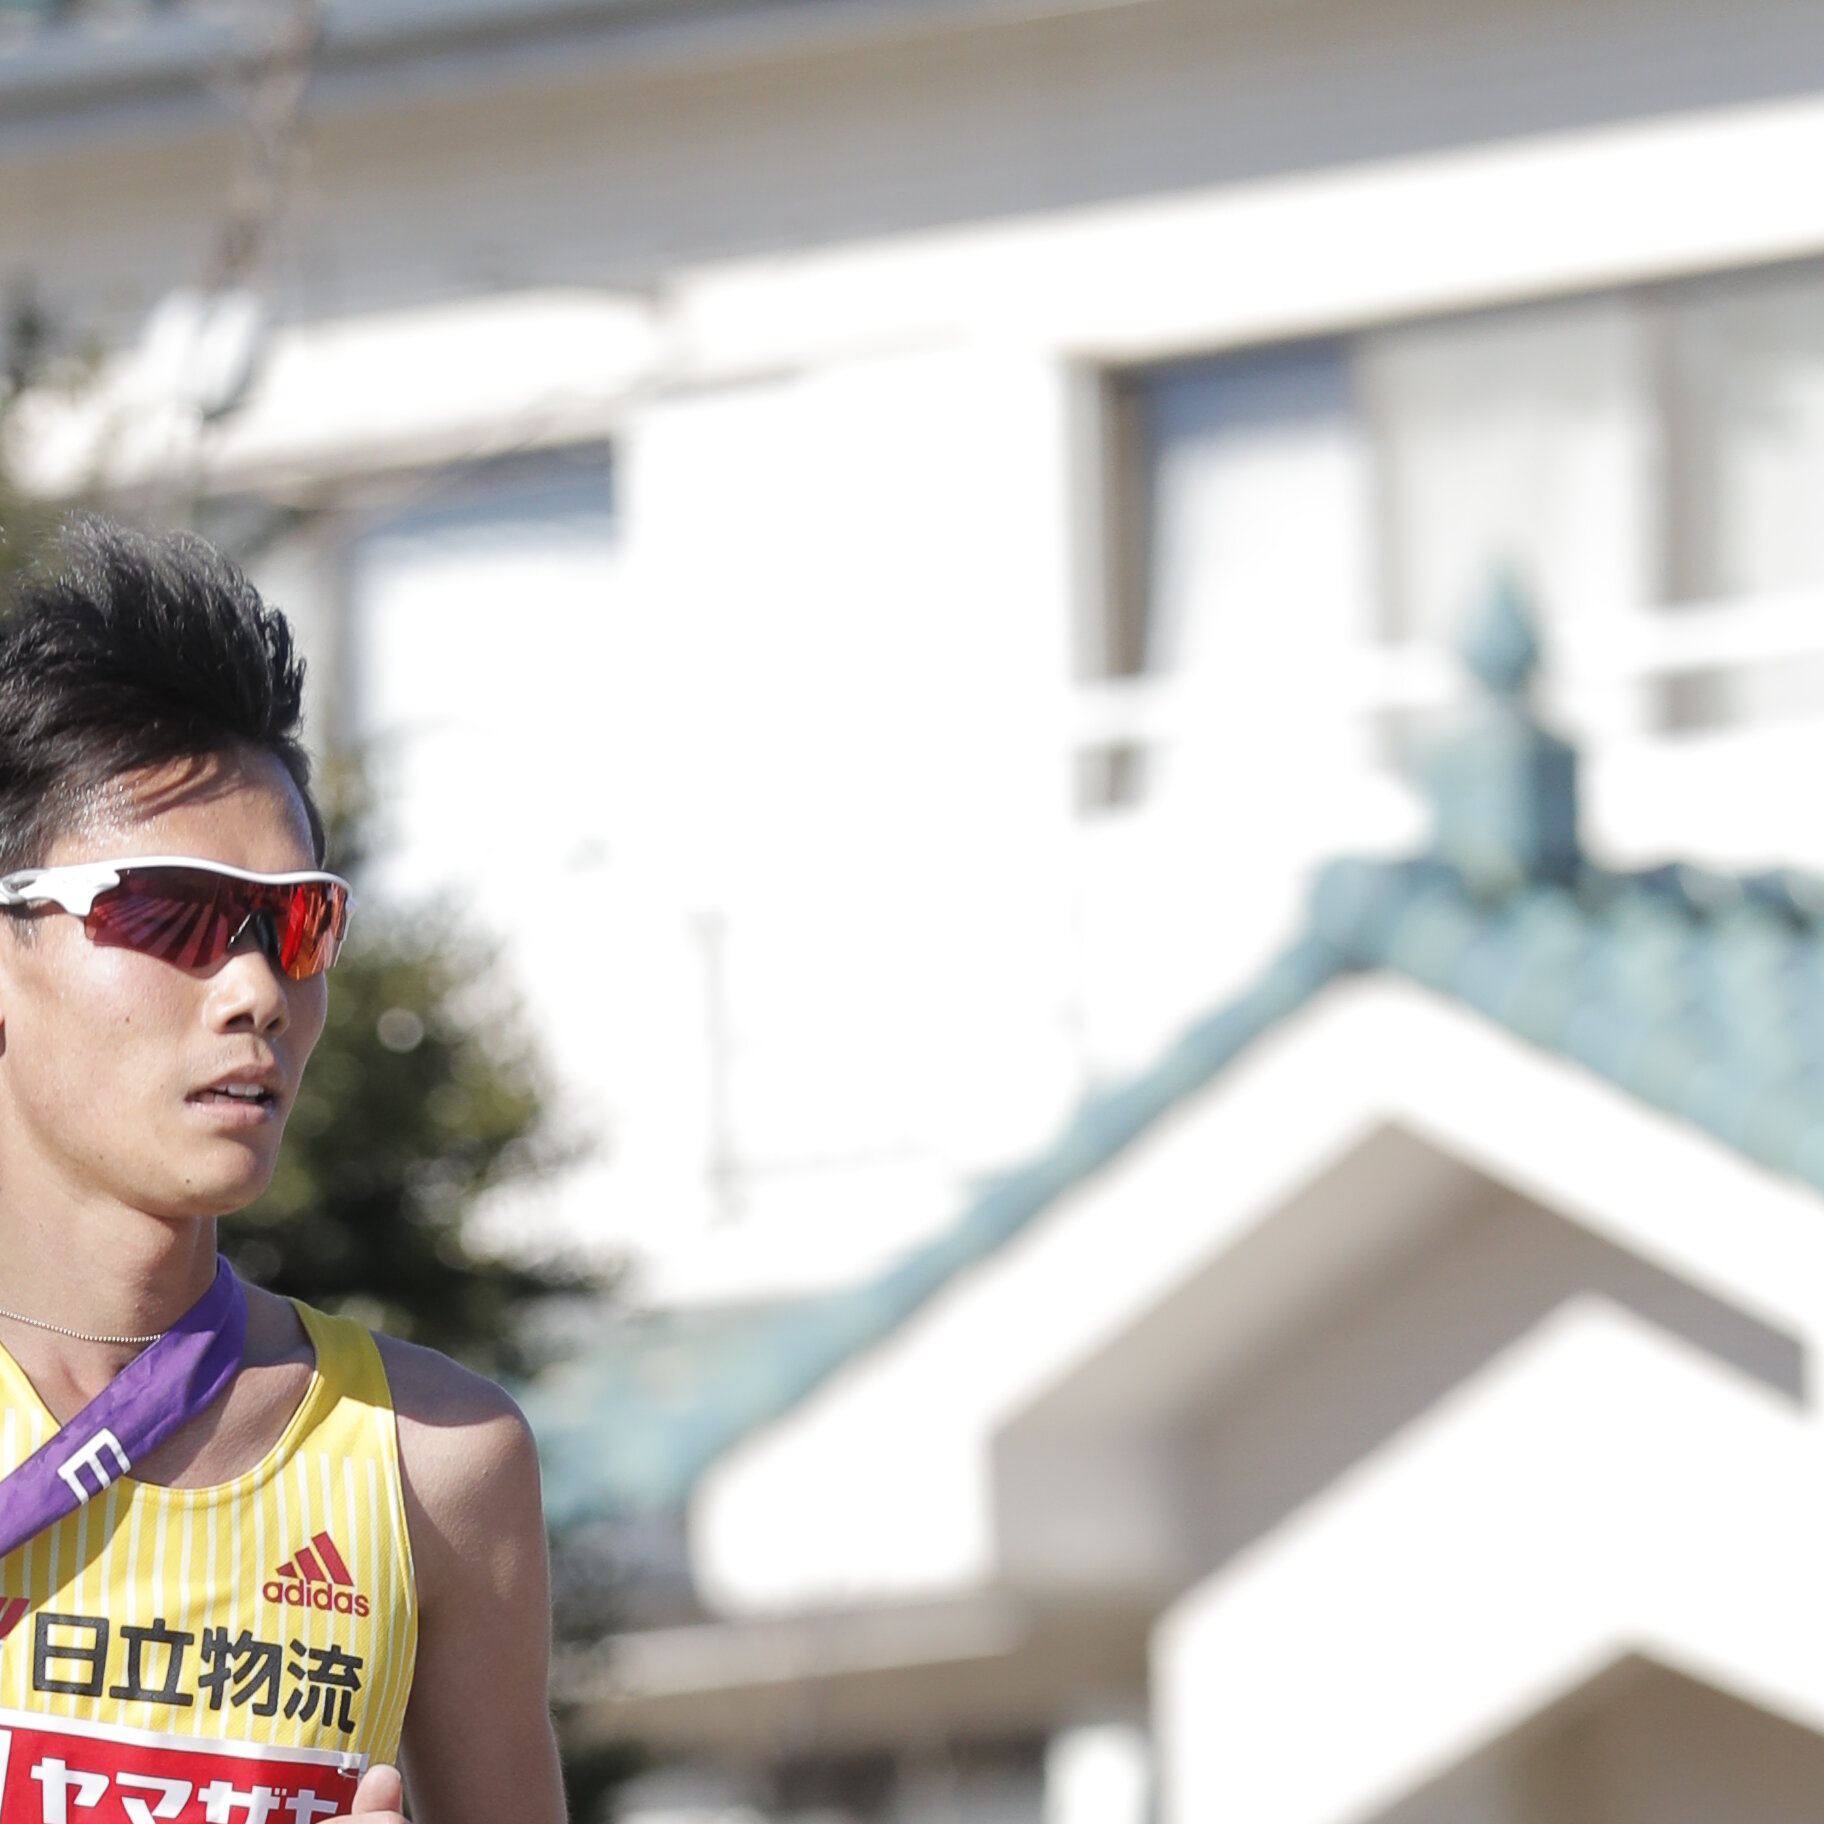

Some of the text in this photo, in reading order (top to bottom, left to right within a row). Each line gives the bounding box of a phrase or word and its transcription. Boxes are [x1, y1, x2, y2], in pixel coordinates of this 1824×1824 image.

[262, 1578, 370, 1618] adidas
[33, 1611, 364, 1734] 日立物流
